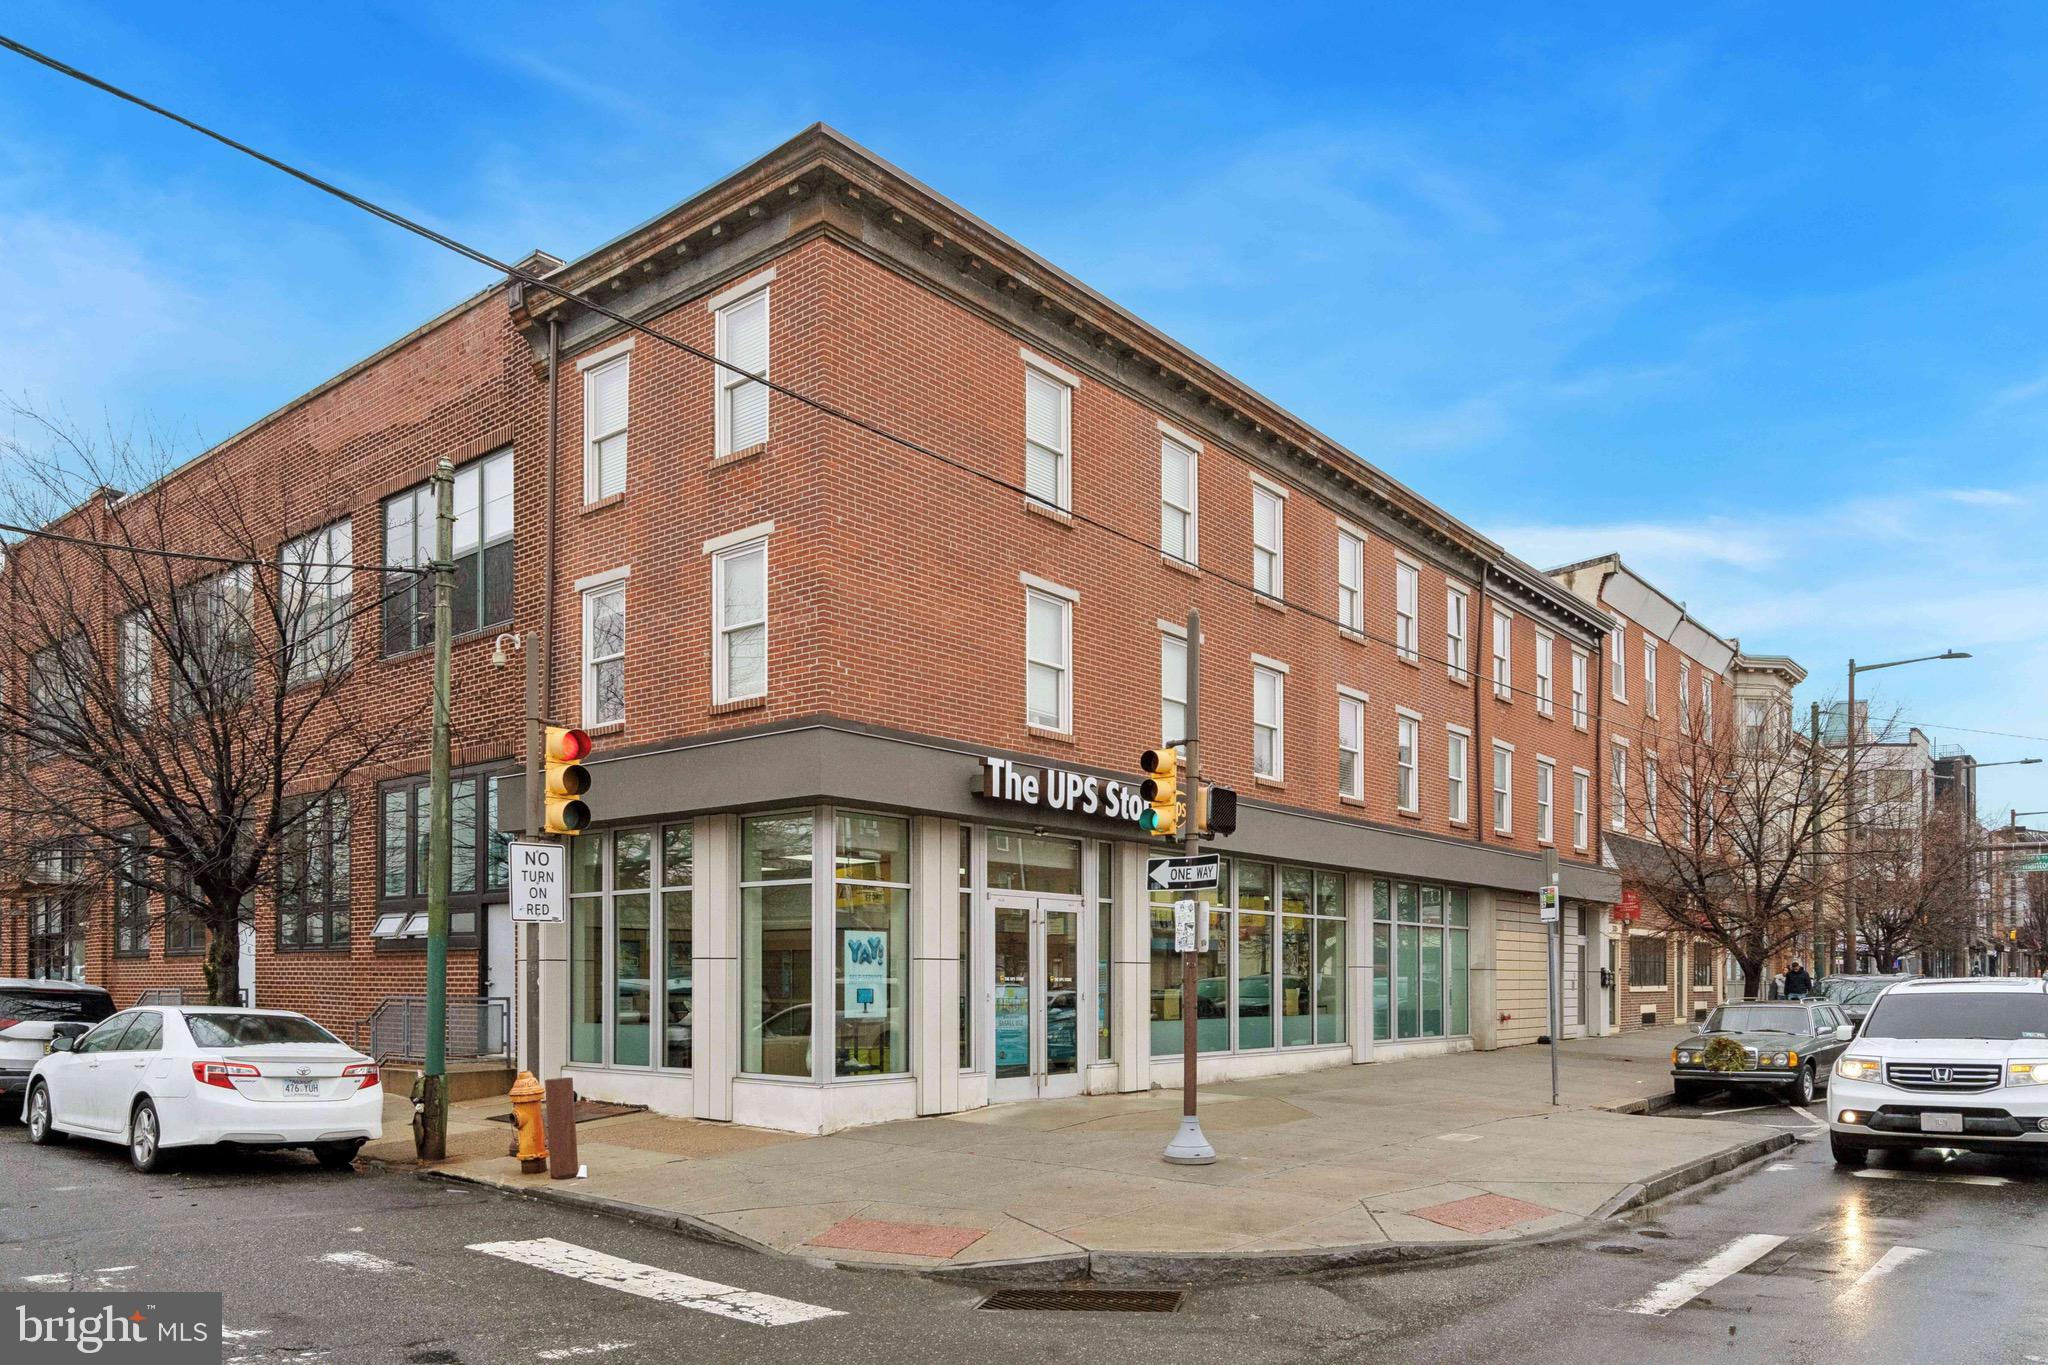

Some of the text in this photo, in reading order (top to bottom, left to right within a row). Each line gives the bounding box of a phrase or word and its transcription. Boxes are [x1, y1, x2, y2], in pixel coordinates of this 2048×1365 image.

[988, 757, 1039, 805] The
[1047, 770, 1098, 814] UPS
[525, 851, 550, 866] NO
[521, 870, 554, 883] TURN
[1170, 866, 1214, 881] ONE WAY
[529, 887, 547, 899] ON
[526, 904, 550, 916] RED
[848, 936, 884, 966] YAY!
